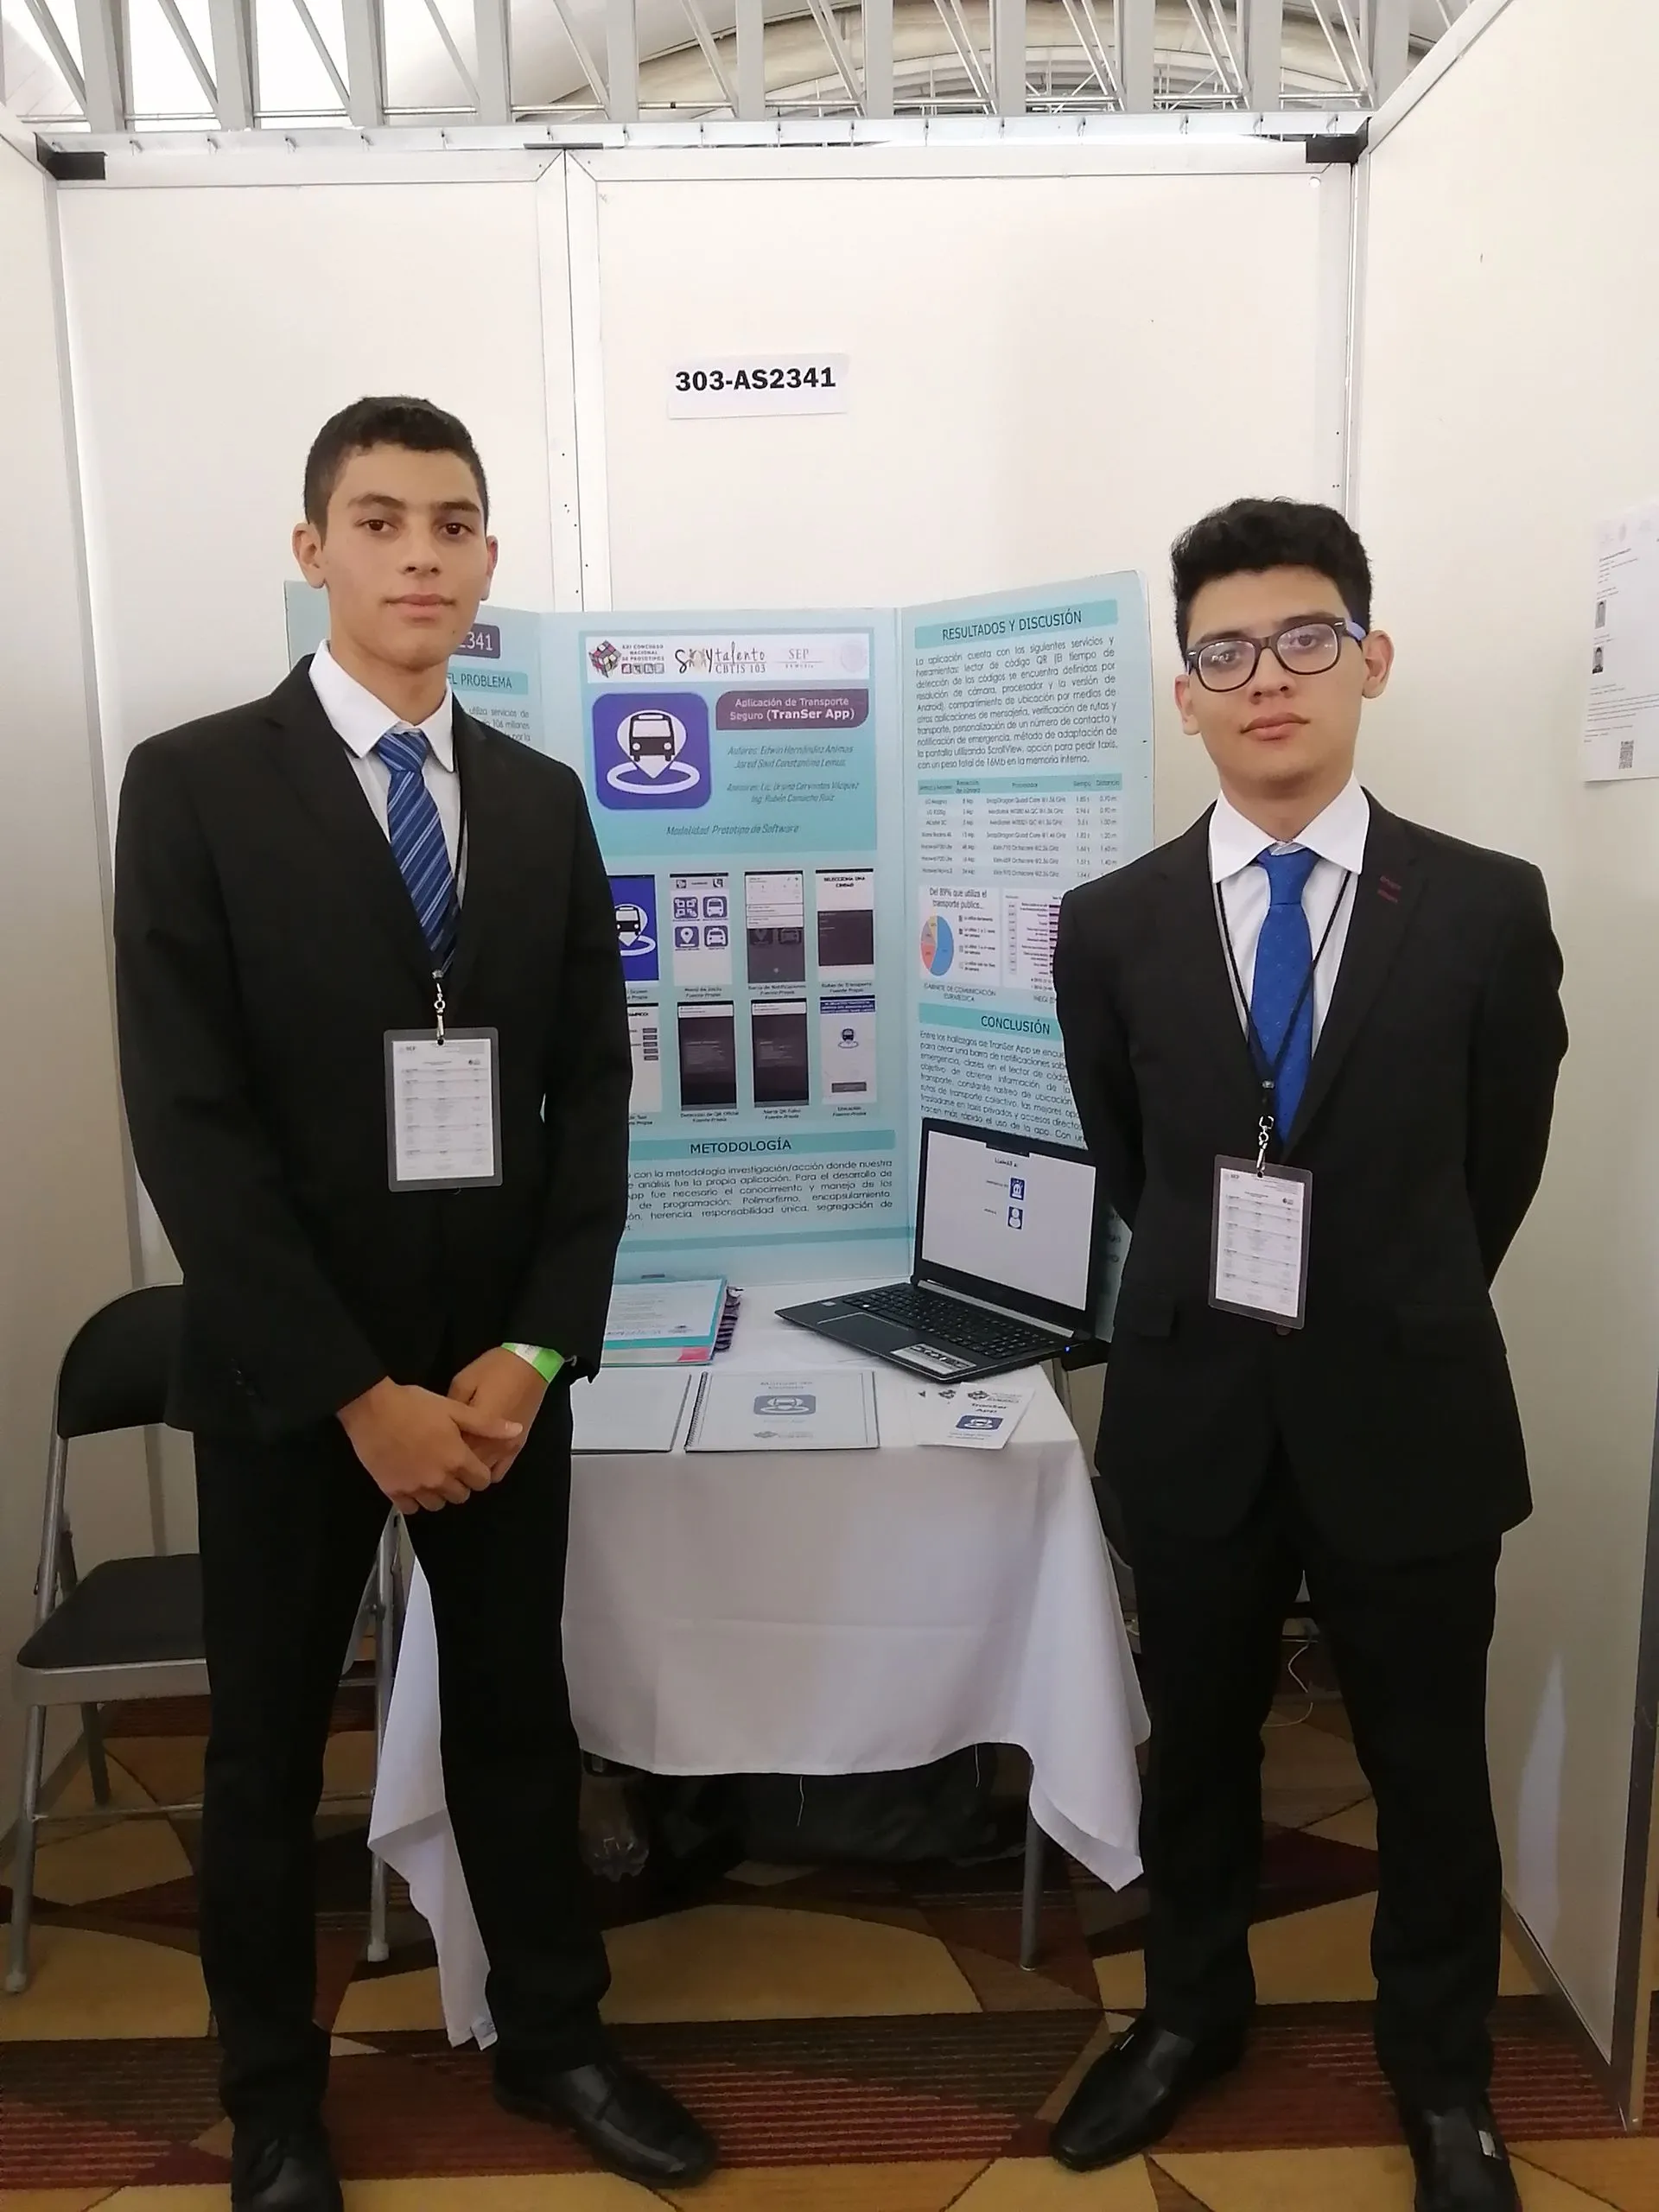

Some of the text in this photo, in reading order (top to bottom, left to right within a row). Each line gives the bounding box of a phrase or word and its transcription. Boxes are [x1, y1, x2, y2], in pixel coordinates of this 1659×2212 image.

[675, 366, 836, 391] 303-AS2341
[942, 607, 1082, 640] RESULTADOS Y DISCUSIÓN
[715, 641, 765, 664] talento
[788, 648, 810, 660] SEP
[996, 648, 1011, 657] con
[1109, 636, 1115, 646] y
[989, 661, 1000, 670] de
[1103, 648, 1115, 658] de
[750, 663, 766, 674] 103
[1101, 662, 1116, 673] por
[461, 674, 512, 689] PROBLEMA
[1104, 673, 1116, 684] de
[735, 696, 849, 708] Aplicación de Transporte
[1057, 691, 1070, 702] por
[1104, 687, 1117, 697] de
[1077, 702, 1089, 712] de
[1111, 701, 1117, 712] y
[729, 708, 855, 722] Seguro (TranSer App)
[1060, 716, 1071, 726] de
[1072, 713, 1110, 725] contacto
[1111, 715, 1117, 724] y
[1045, 730, 1056, 740] de
[1106, 725, 1118, 736] de
[1054, 741, 1073, 753] para
[981, 1015, 1050, 1035] CONCLUSIÓN
[690, 1136, 791, 1154] METODOLOGÍA
[634, 1160, 893, 1179] con la metodología investigación/acción donde nuestra
[638, 1179, 671, 1189] análisis
[674, 1179, 690, 1188] fue
[693, 1178, 702, 1187] la
[705, 1177, 736, 1187] propia
[795, 1173, 817, 1182] Para
[821, 1172, 829, 1181] el
[832, 1169, 876, 1180] desarrollo
[880, 1168, 893, 1178] de
[651, 1189, 666, 1199] fue
[672, 1188, 718, 1198] necesario
[724, 1187, 734, 1196] el
[739, 1183, 803, 1195] conocimiento
[821, 1180, 855, 1191] manejo
[861, 1179, 874, 1189] de
[639, 1201, 652, 1210] de
[817, 1199, 874, 1211] segregación
[880, 1199, 893, 1209] de
